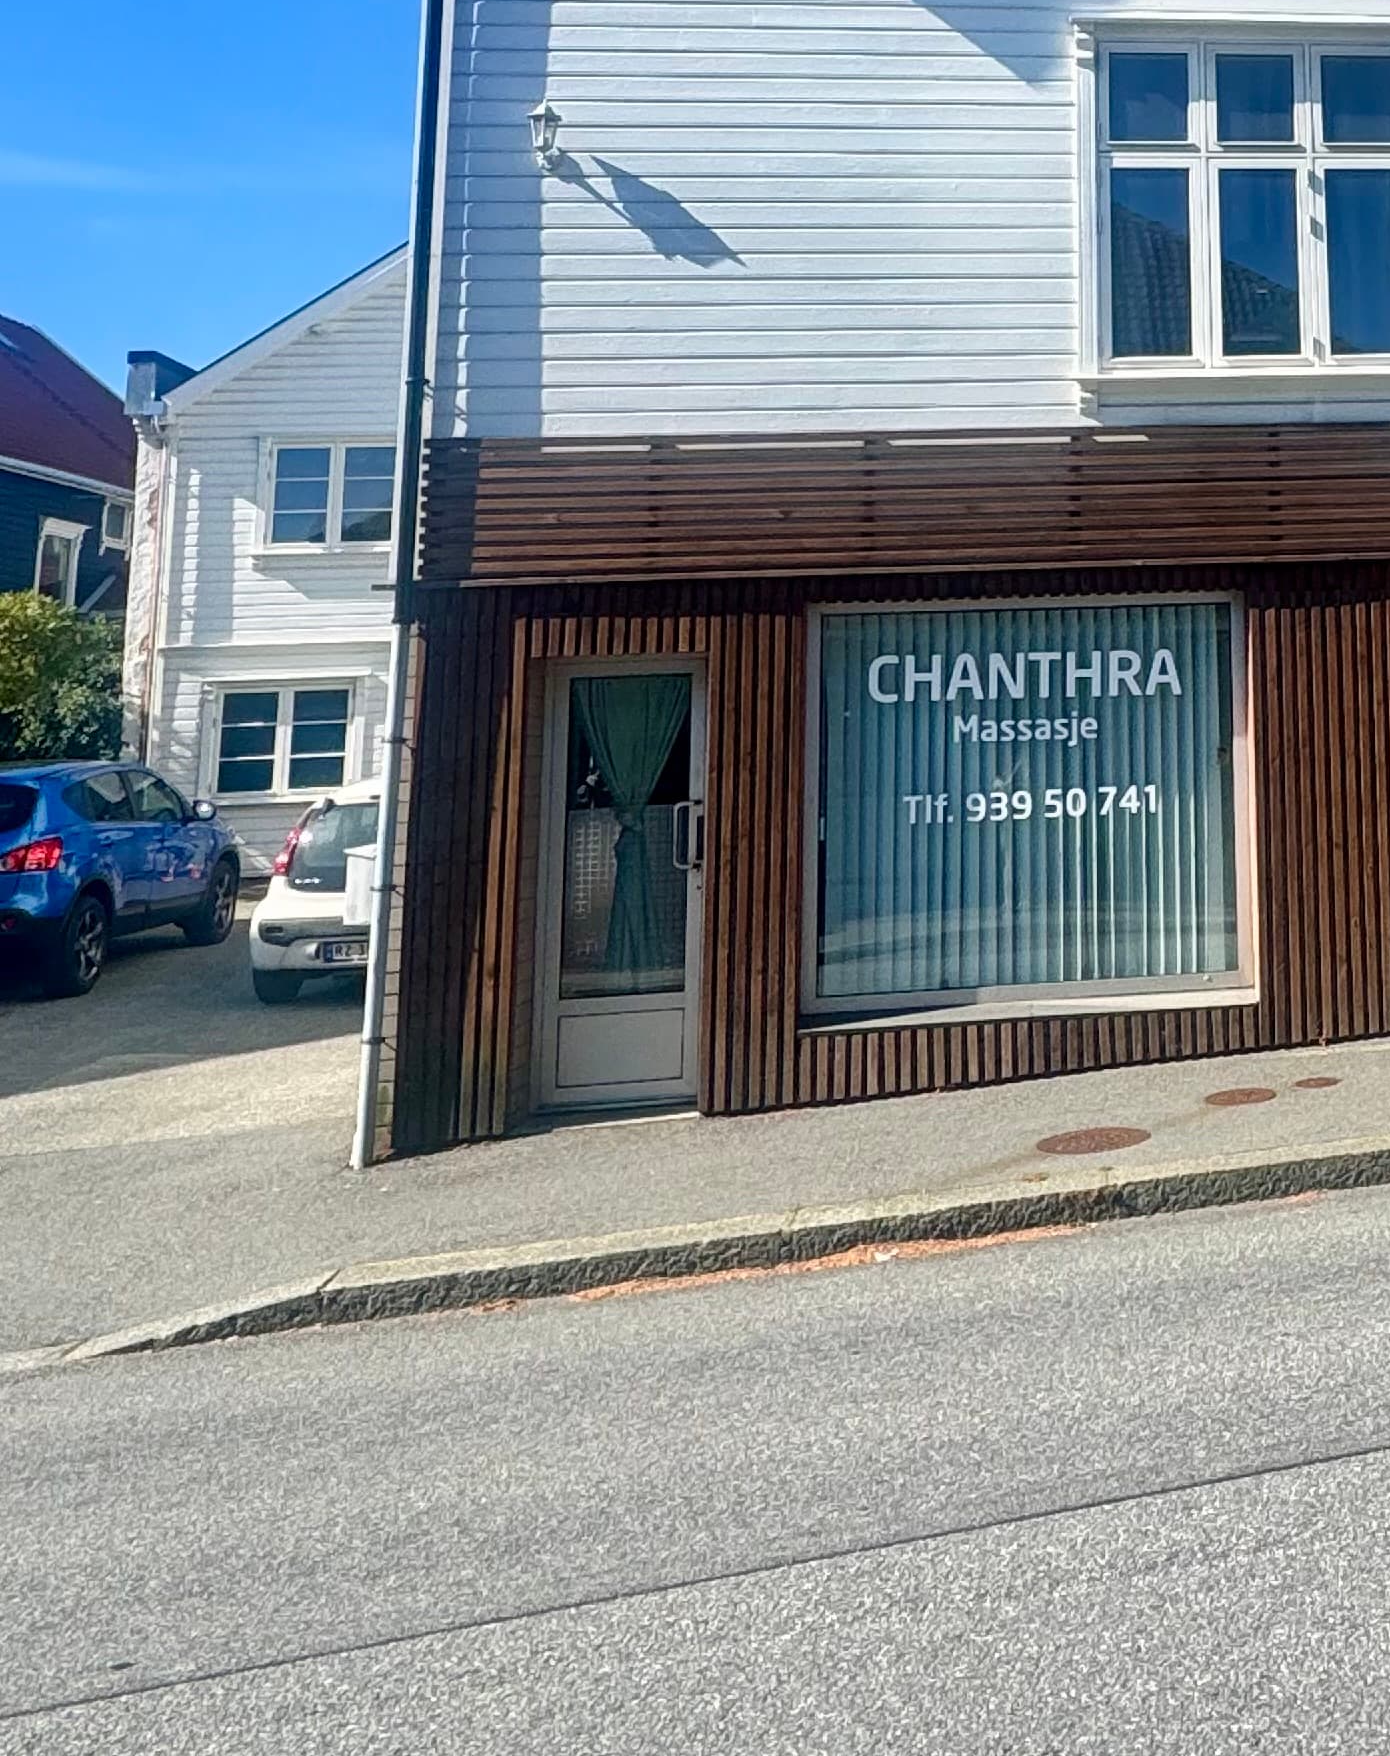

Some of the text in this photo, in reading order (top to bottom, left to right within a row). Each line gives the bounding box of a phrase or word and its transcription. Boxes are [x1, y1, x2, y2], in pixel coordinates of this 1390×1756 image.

[868, 649, 1182, 703] CHANTHRA
[953, 711, 1098, 747] Massasje
[903, 785, 1157, 824] Tlf. 939 50 741
